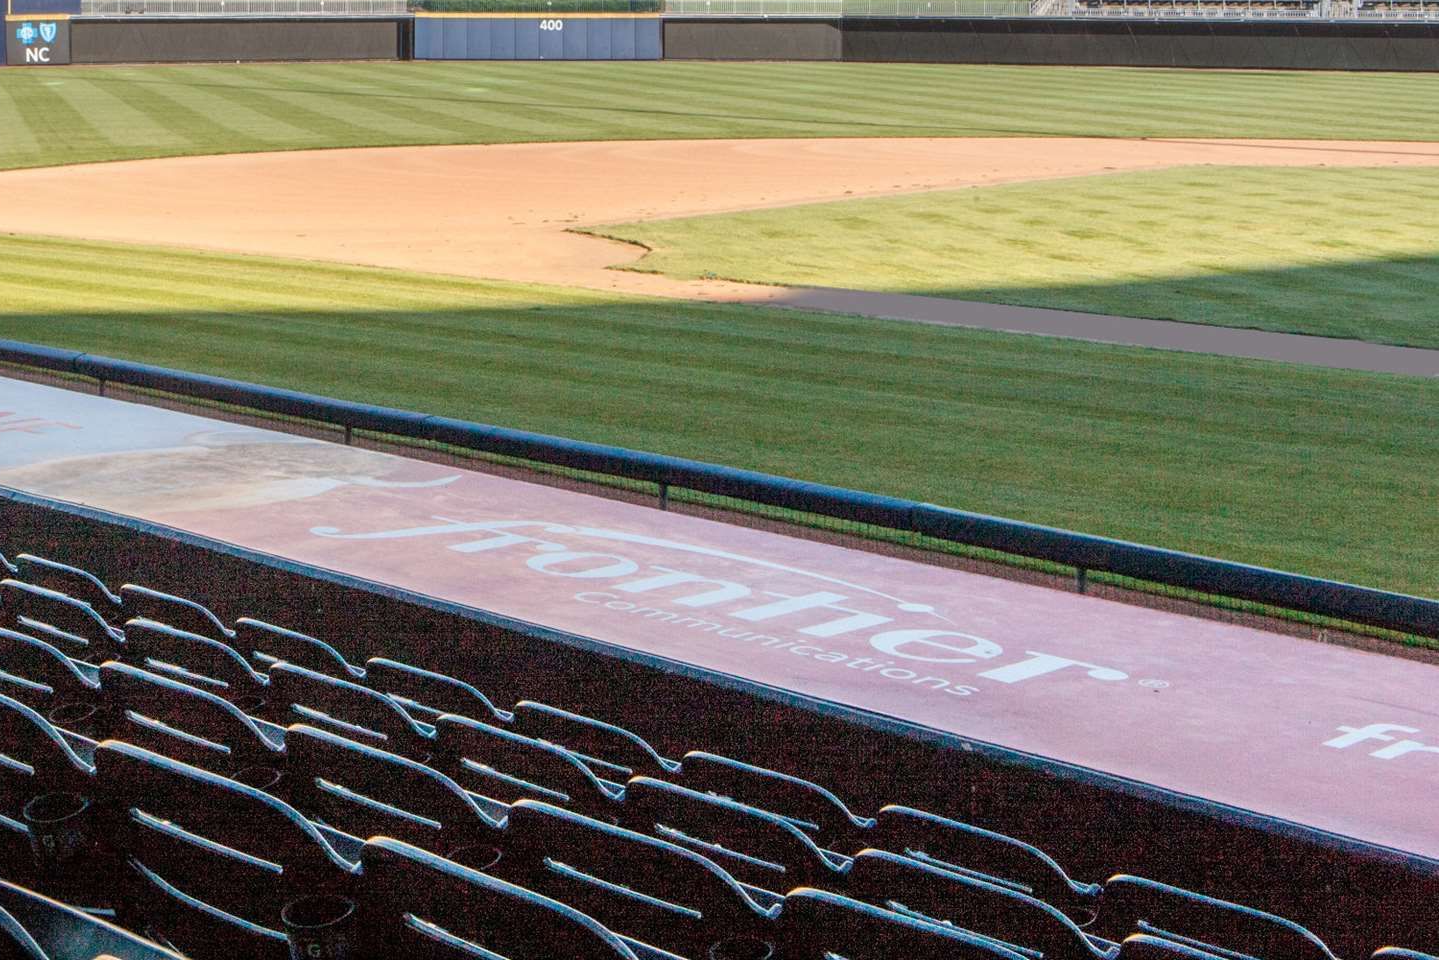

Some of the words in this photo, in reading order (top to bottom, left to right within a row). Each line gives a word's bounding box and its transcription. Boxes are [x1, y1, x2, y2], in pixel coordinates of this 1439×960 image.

[539, 19, 563, 31] 400
[26, 47, 50, 62] NC
[309, 515, 1130, 686] frontier
